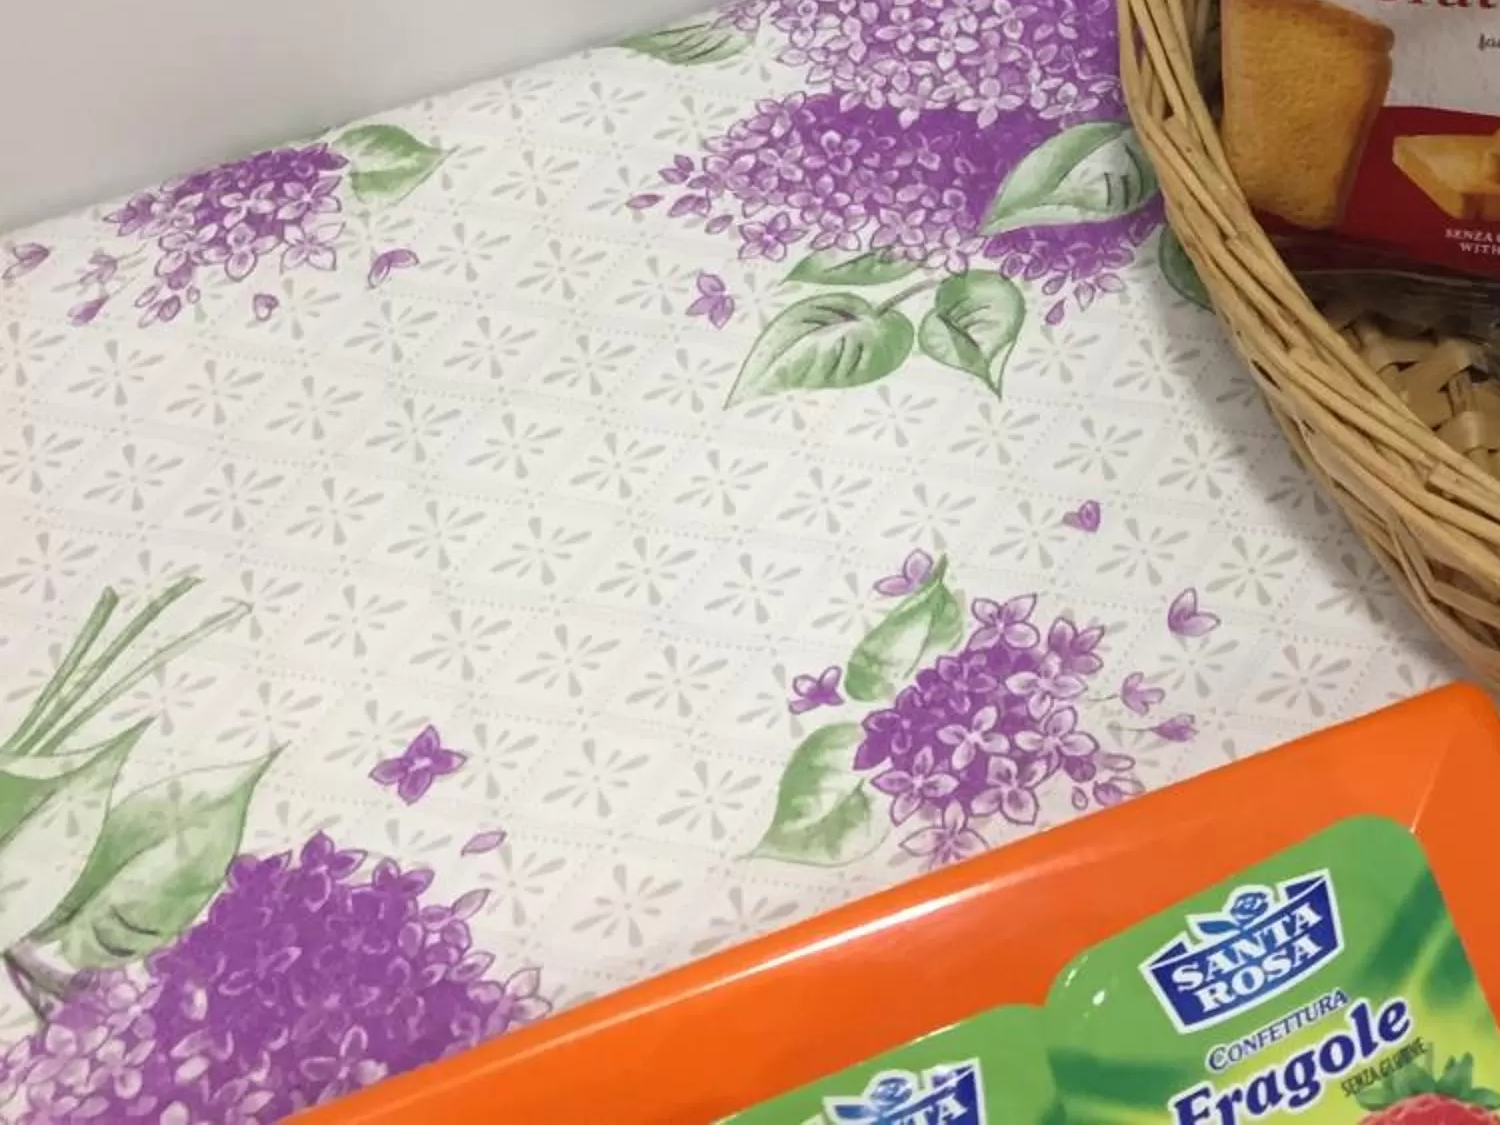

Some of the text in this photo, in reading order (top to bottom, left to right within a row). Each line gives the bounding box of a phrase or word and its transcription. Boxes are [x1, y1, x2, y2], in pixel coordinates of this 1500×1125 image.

[1445, 228, 1493, 242] SENZA
[1171, 902, 1323, 992] SANTA
[1194, 935, 1323, 1013] ROSA
[1174, 1000, 1411, 1125] Fragole
[1208, 988, 1349, 1071] CONFETTURA
